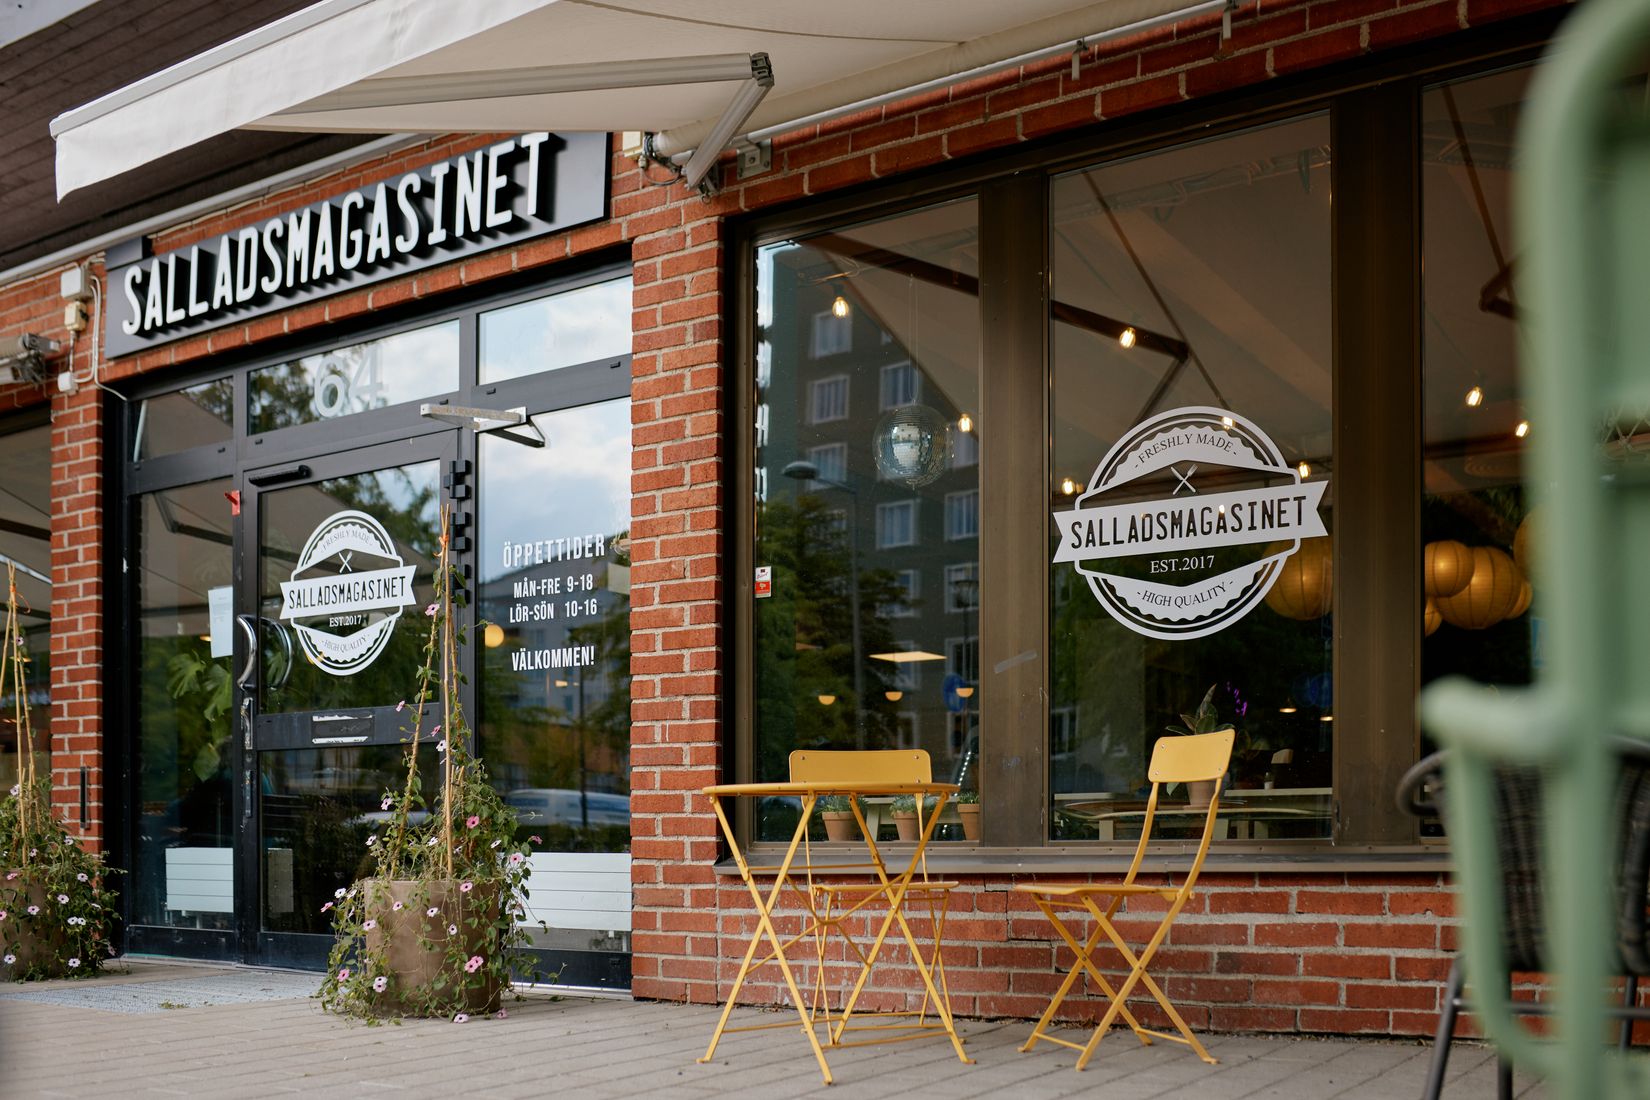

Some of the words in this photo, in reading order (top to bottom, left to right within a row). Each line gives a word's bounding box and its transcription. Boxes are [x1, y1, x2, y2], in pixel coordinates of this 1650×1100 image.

[122, 131, 550, 335] SALLADSMAGASINET
[314, 345, 385, 418] 64
[1138, 433, 1193, 464] FRESHLY
[1196, 433, 1234, 453] MADE
[1071, 495, 1307, 549] SALLADSMAGASINET
[352, 529, 371, 545] MADE
[503, 533, 605, 568] ÖPPETTIDER
[1150, 555, 1215, 574] EST.2017
[289, 576, 406, 610] SALLADSMAGASINET
[513, 577, 561, 599] MÅN-FRE
[567, 574, 594, 593] 9-18
[1141, 589, 1172, 607] HIGH
[1174, 581, 1226, 609] QUALITY
[329, 614, 362, 627] EST.2017
[509, 601, 555, 623] LÖR-SÖN
[564, 598, 598, 617] 10-16
[324, 639, 340, 652] HIGH
[340, 634, 368, 653] QUALITY
[511, 645, 595, 671] VÄLKOMMEN!
